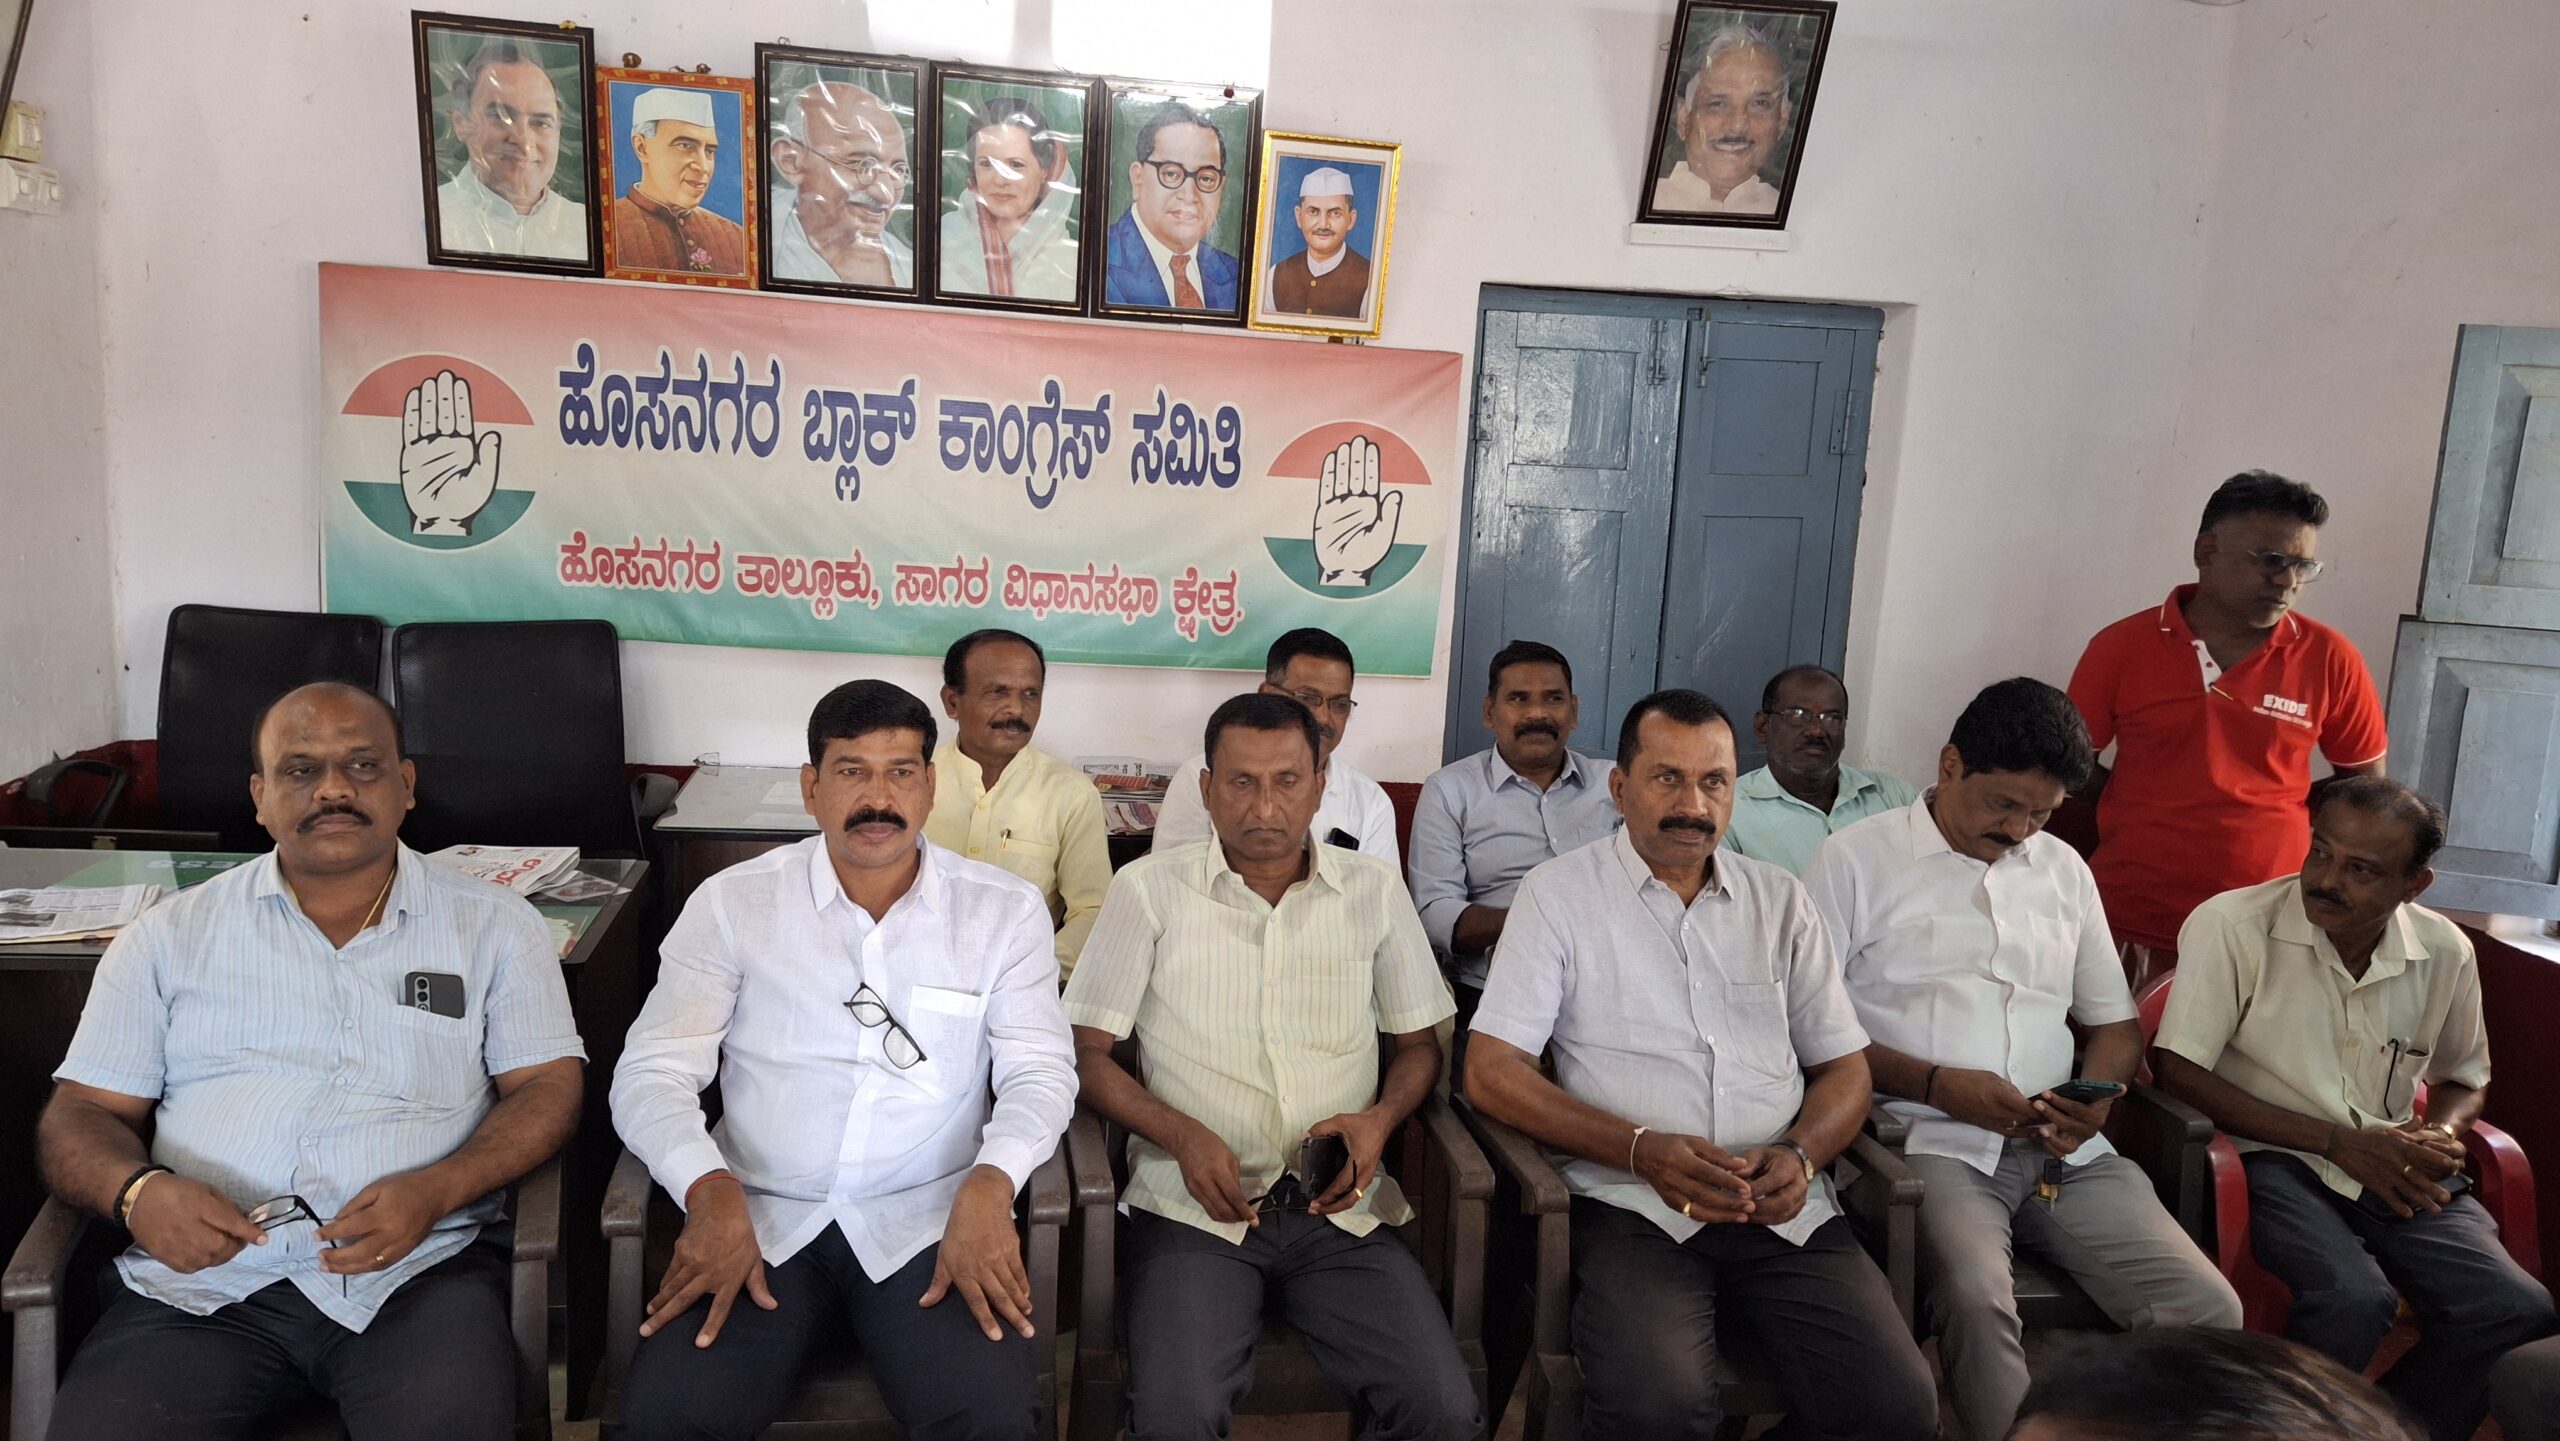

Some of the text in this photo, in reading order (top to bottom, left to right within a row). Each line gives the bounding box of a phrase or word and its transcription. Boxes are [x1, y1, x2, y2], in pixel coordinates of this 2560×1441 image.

[560, 343, 1242, 509] ಹೊಸನಗರ ಬ್ಲಾಕ್ ಕಾಂಗ್ರೆಸ್ ಸಮಿತಿ
[561, 531, 721, 591] ಹೊಸನಗರ
[737, 550, 880, 618] ತಾಲ್ಲೂಕು,
[896, 556, 990, 605] ಸಾಗರ
[1004, 563, 1159, 621] ವಿಧಾನಸಭಾ
[2262, 693, 2309, 717] EXIDE
